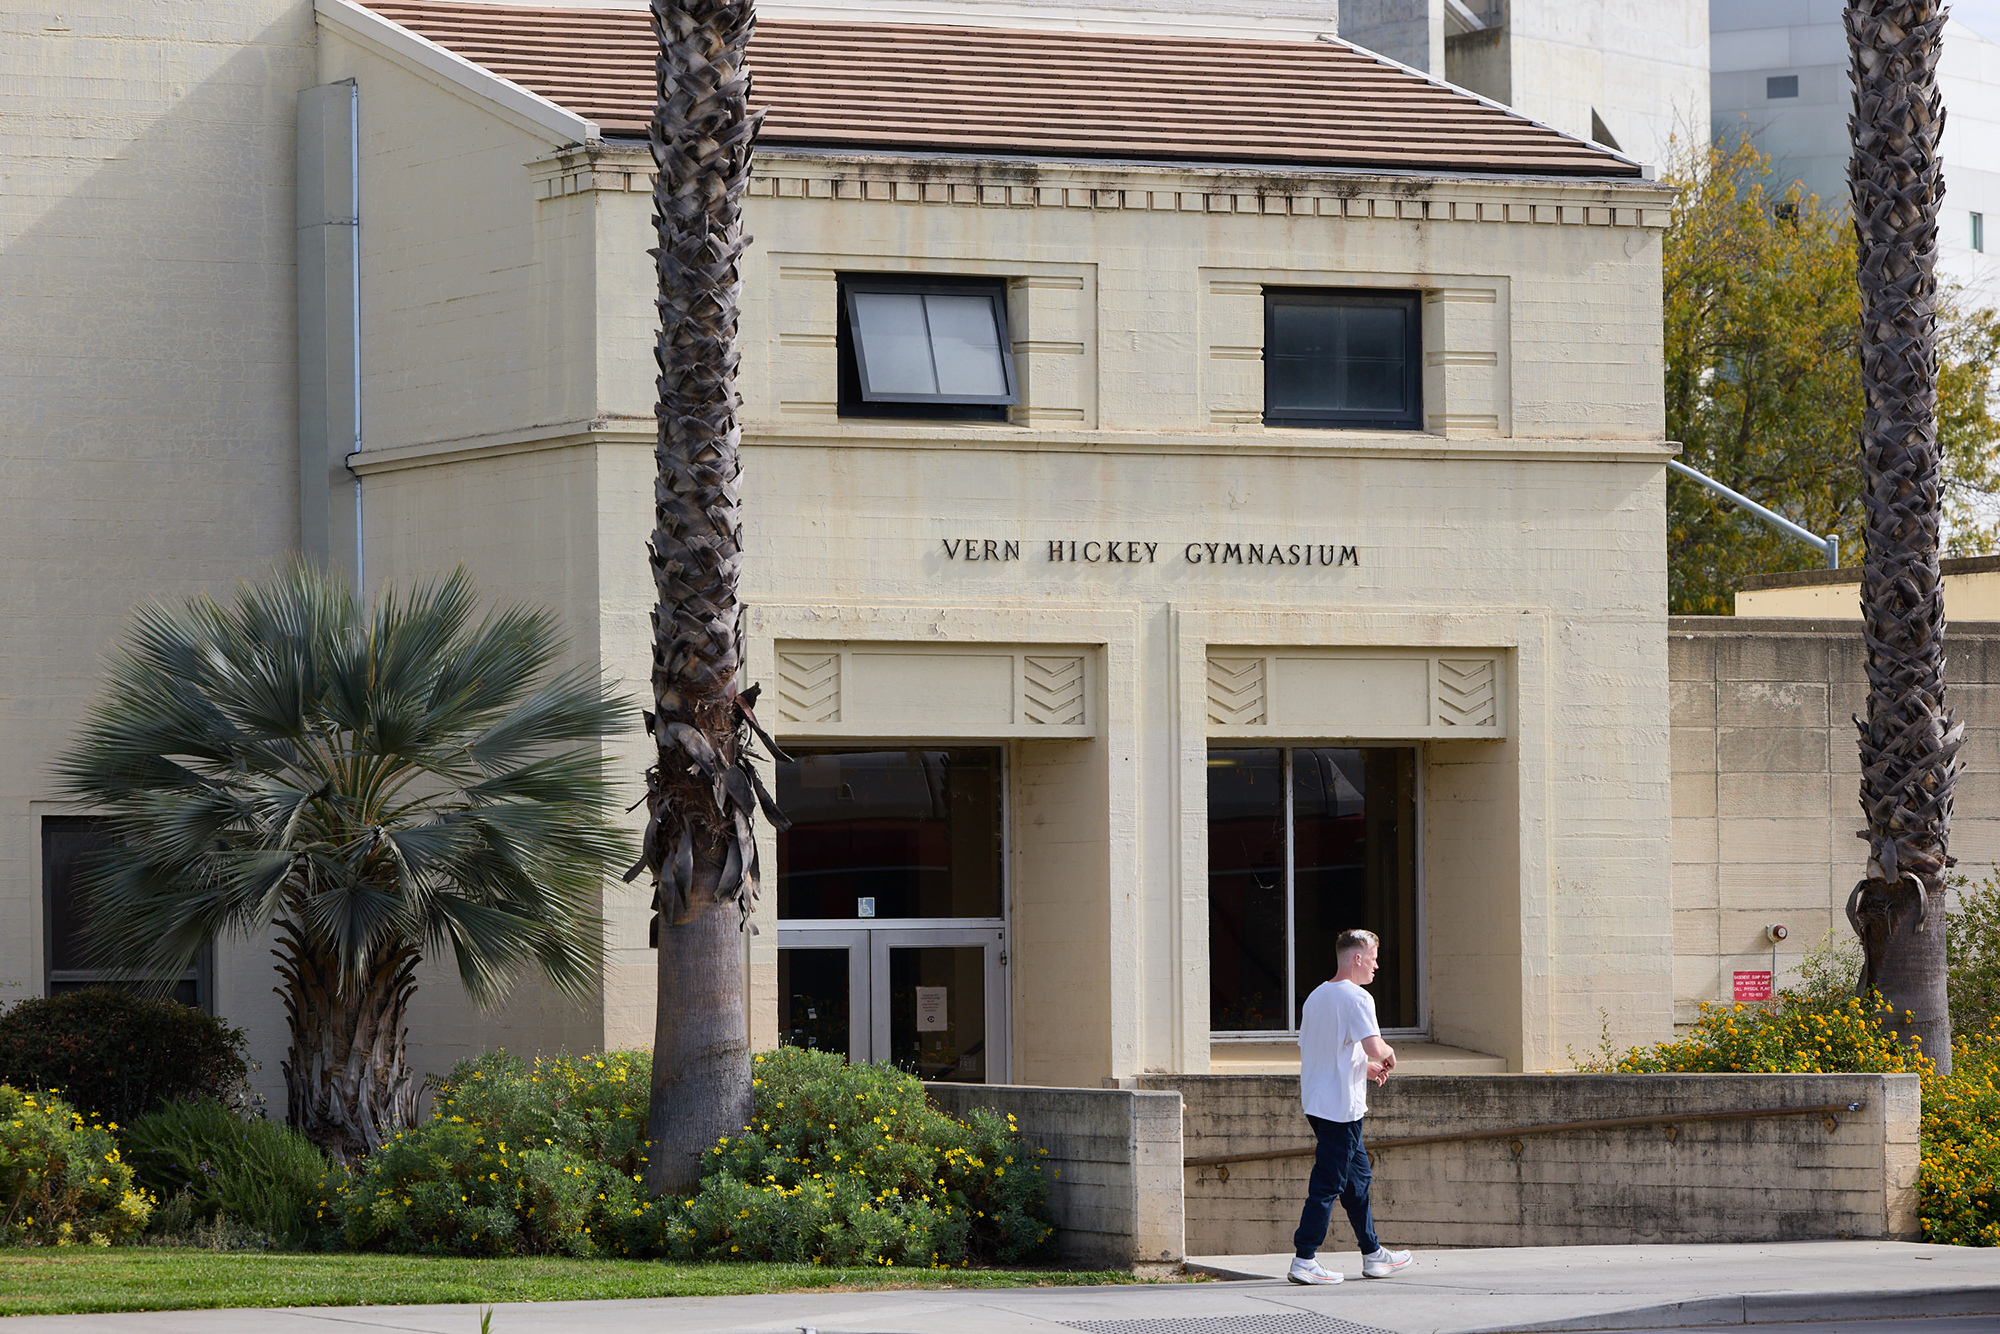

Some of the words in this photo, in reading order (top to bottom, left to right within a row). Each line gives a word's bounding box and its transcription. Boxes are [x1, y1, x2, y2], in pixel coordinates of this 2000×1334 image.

[942, 538, 1020, 561] VERN
[1048, 540, 1158, 563] HICKEY
[1185, 542, 1359, 566] GYMNASIUM
